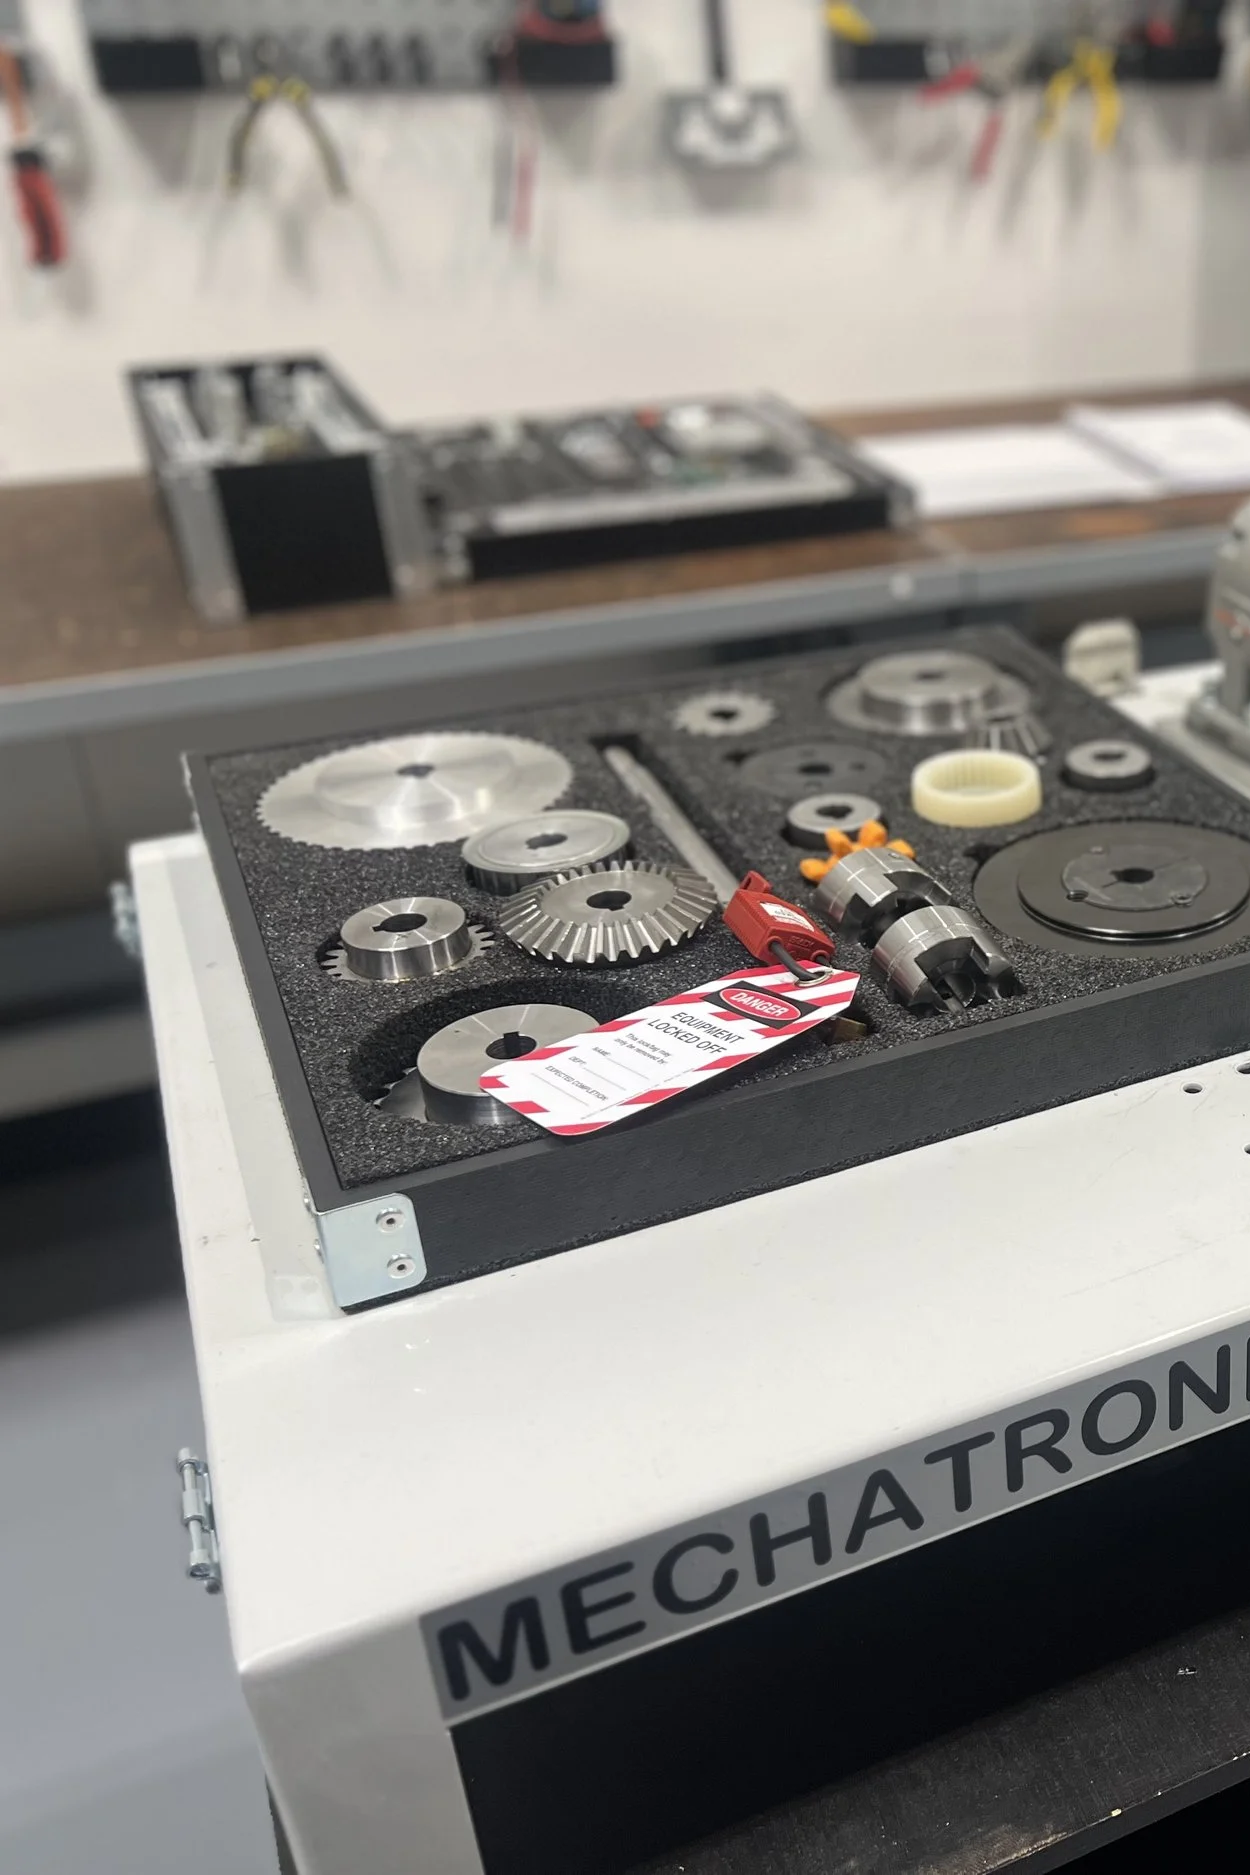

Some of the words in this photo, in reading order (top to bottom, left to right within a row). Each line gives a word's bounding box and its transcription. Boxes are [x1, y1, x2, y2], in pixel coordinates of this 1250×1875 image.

[730, 992, 789, 1017] DANGER
[647, 1018, 700, 1044] LOCKED
[696, 1040, 727, 1054] OFF
[671, 1012, 745, 1044] EQUIPMENT
[545, 1065, 575, 1083] EXPECTED
